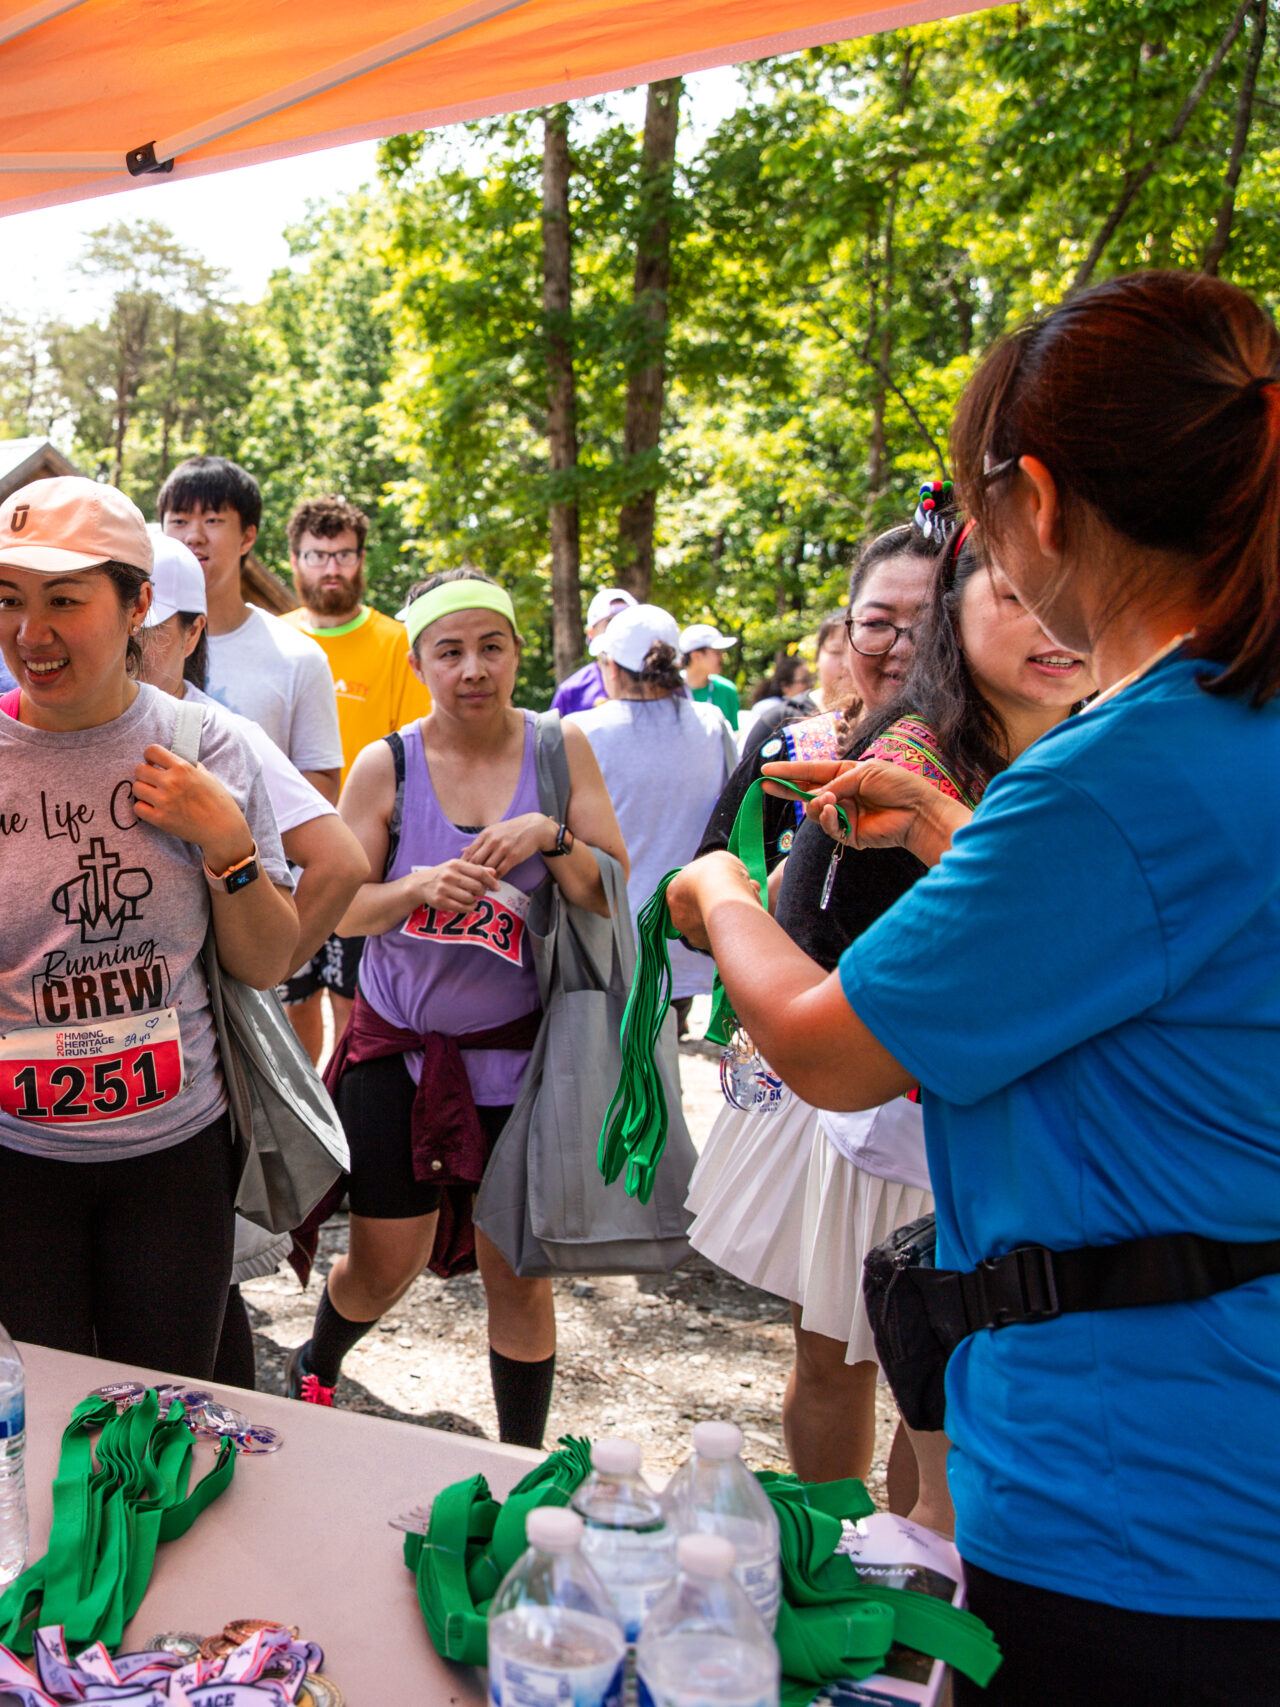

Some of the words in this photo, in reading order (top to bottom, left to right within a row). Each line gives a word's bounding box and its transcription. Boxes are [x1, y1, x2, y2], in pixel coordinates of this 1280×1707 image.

[41, 790, 95, 844] Life
[417, 899, 514, 951] 1223
[43, 939, 160, 983] Running
[42, 964, 163, 1024] CREW
[56, 1032, 65, 1057] 2025
[64, 1030, 104, 1041] HMONG
[64, 1036, 115, 1049] HERITAGE
[65, 1048, 88, 1057] RUN
[89, 1046, 103, 1055] 5K
[14, 1051, 166, 1117] 1251
